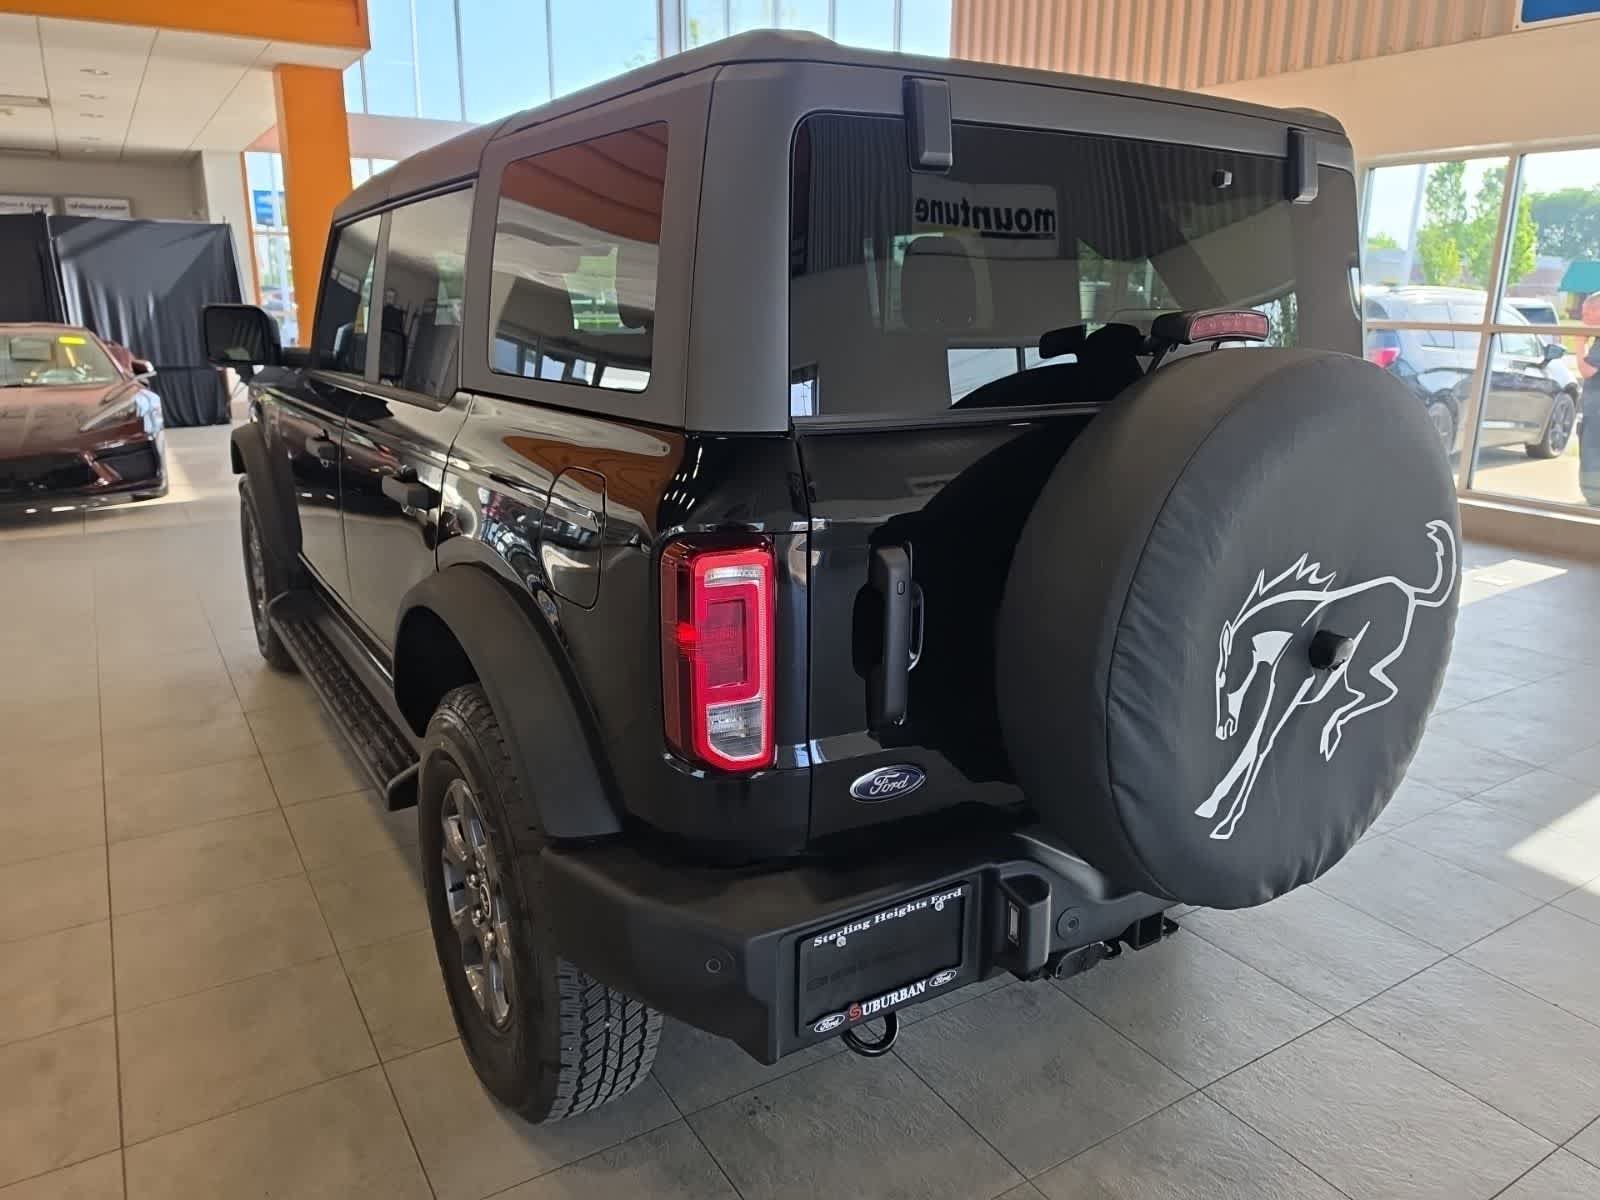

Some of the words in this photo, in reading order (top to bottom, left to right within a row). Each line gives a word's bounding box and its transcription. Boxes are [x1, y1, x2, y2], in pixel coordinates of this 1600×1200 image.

[869, 772, 910, 795] Ford
[813, 919, 871, 947] Sterling
[874, 900, 928, 925] Heights
[930, 887, 962, 906] Ford
[819, 1016, 842, 1031] Ford
[848, 980, 927, 1021] SUBURBAN
[933, 970, 954, 985] Ford
